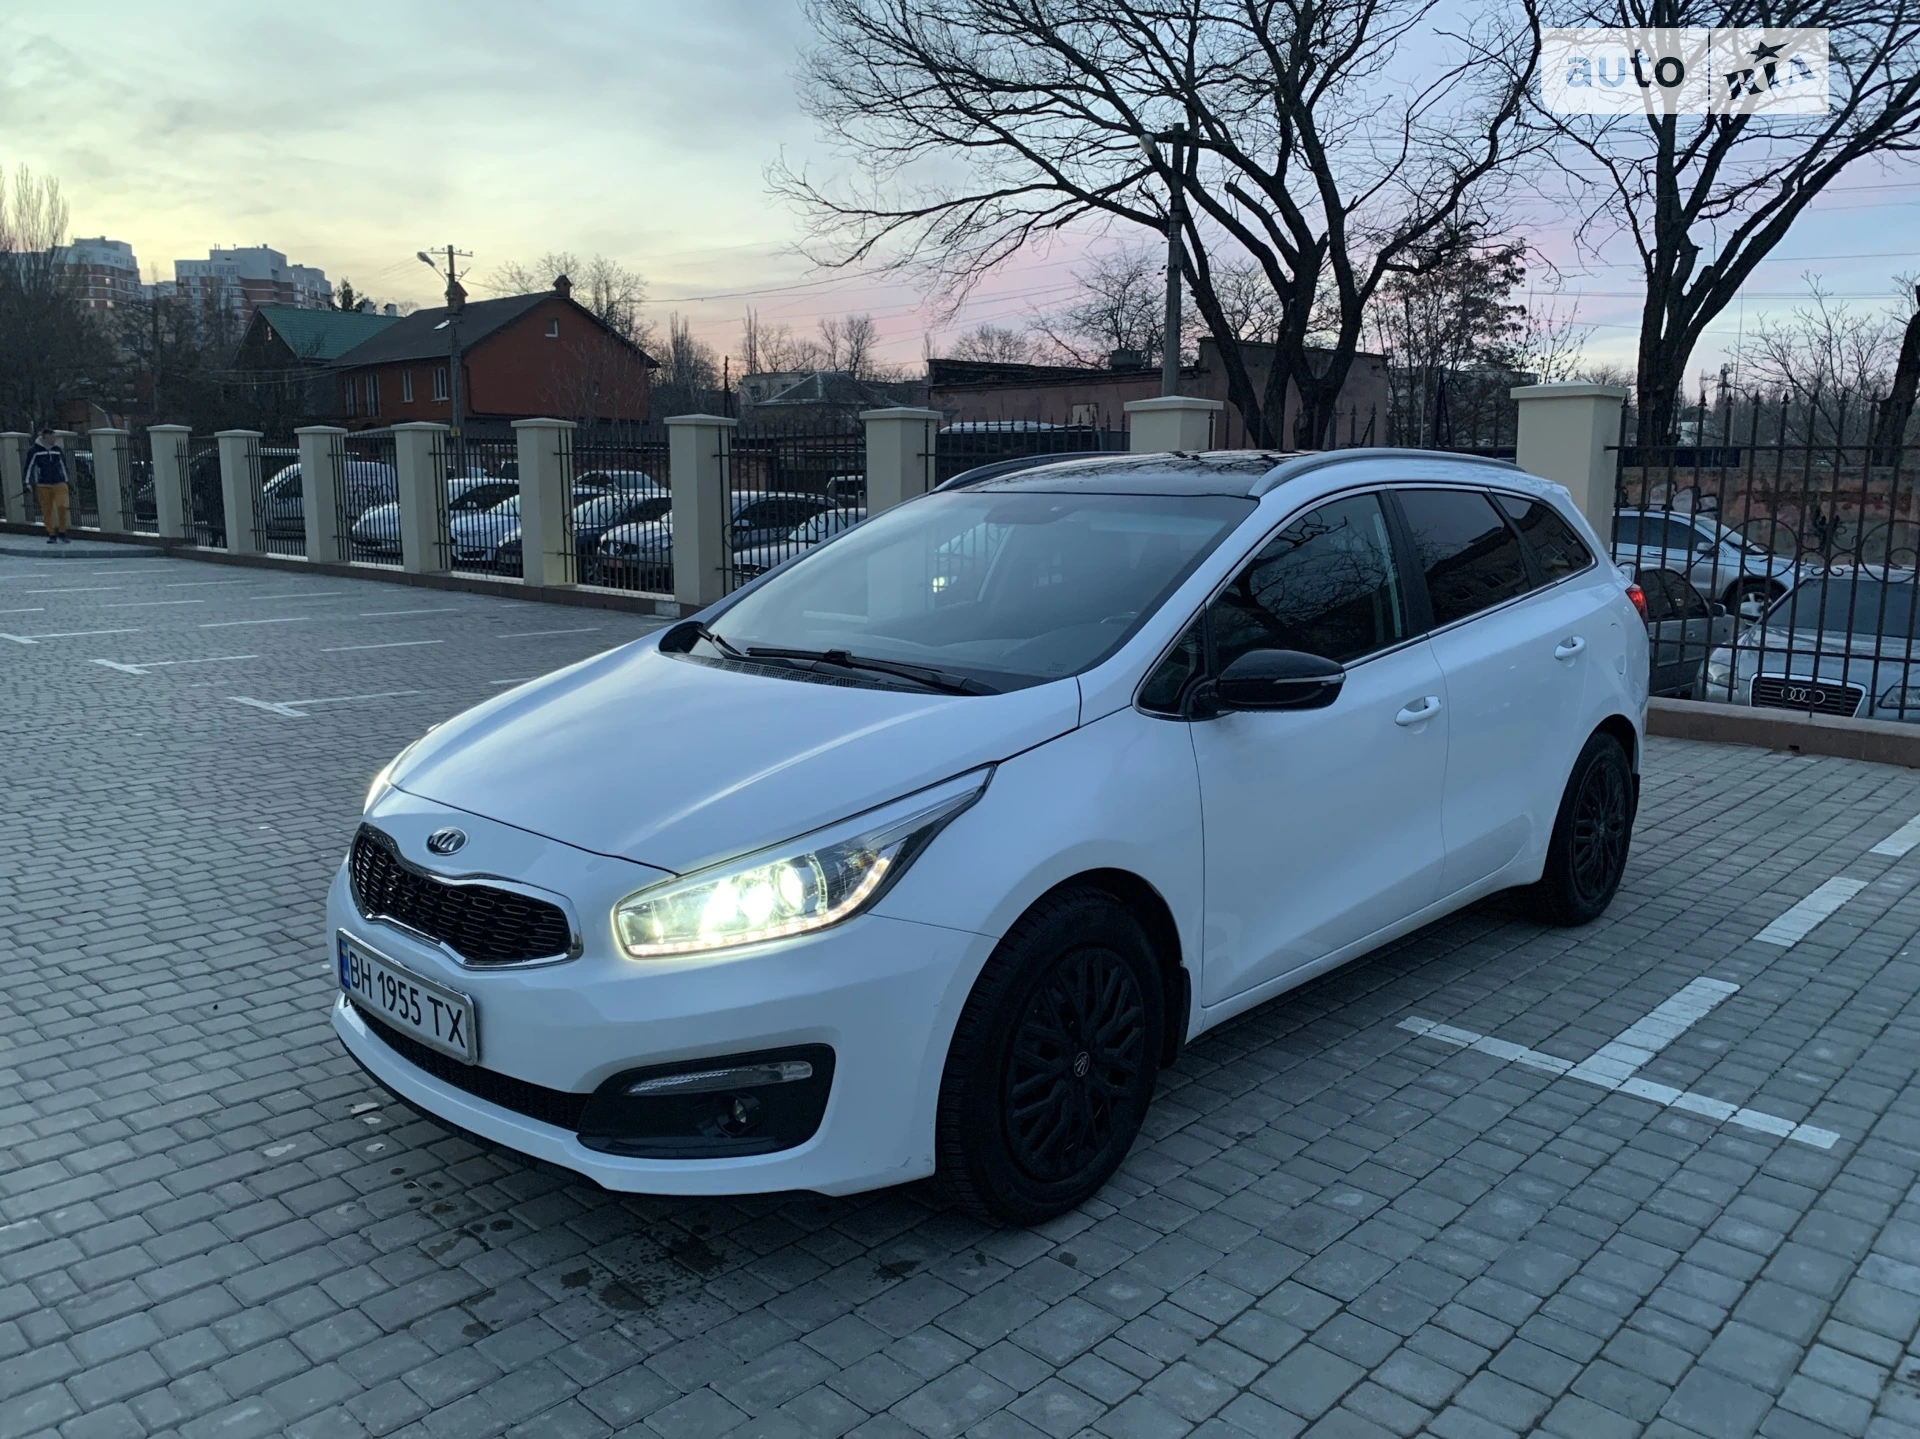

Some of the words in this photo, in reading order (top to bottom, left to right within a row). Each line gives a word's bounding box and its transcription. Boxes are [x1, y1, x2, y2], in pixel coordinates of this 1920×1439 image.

[429, 830, 461, 851] KIA
[349, 950, 373, 999] BH
[377, 970, 422, 1026] 1955
[427, 995, 466, 1049] TX
